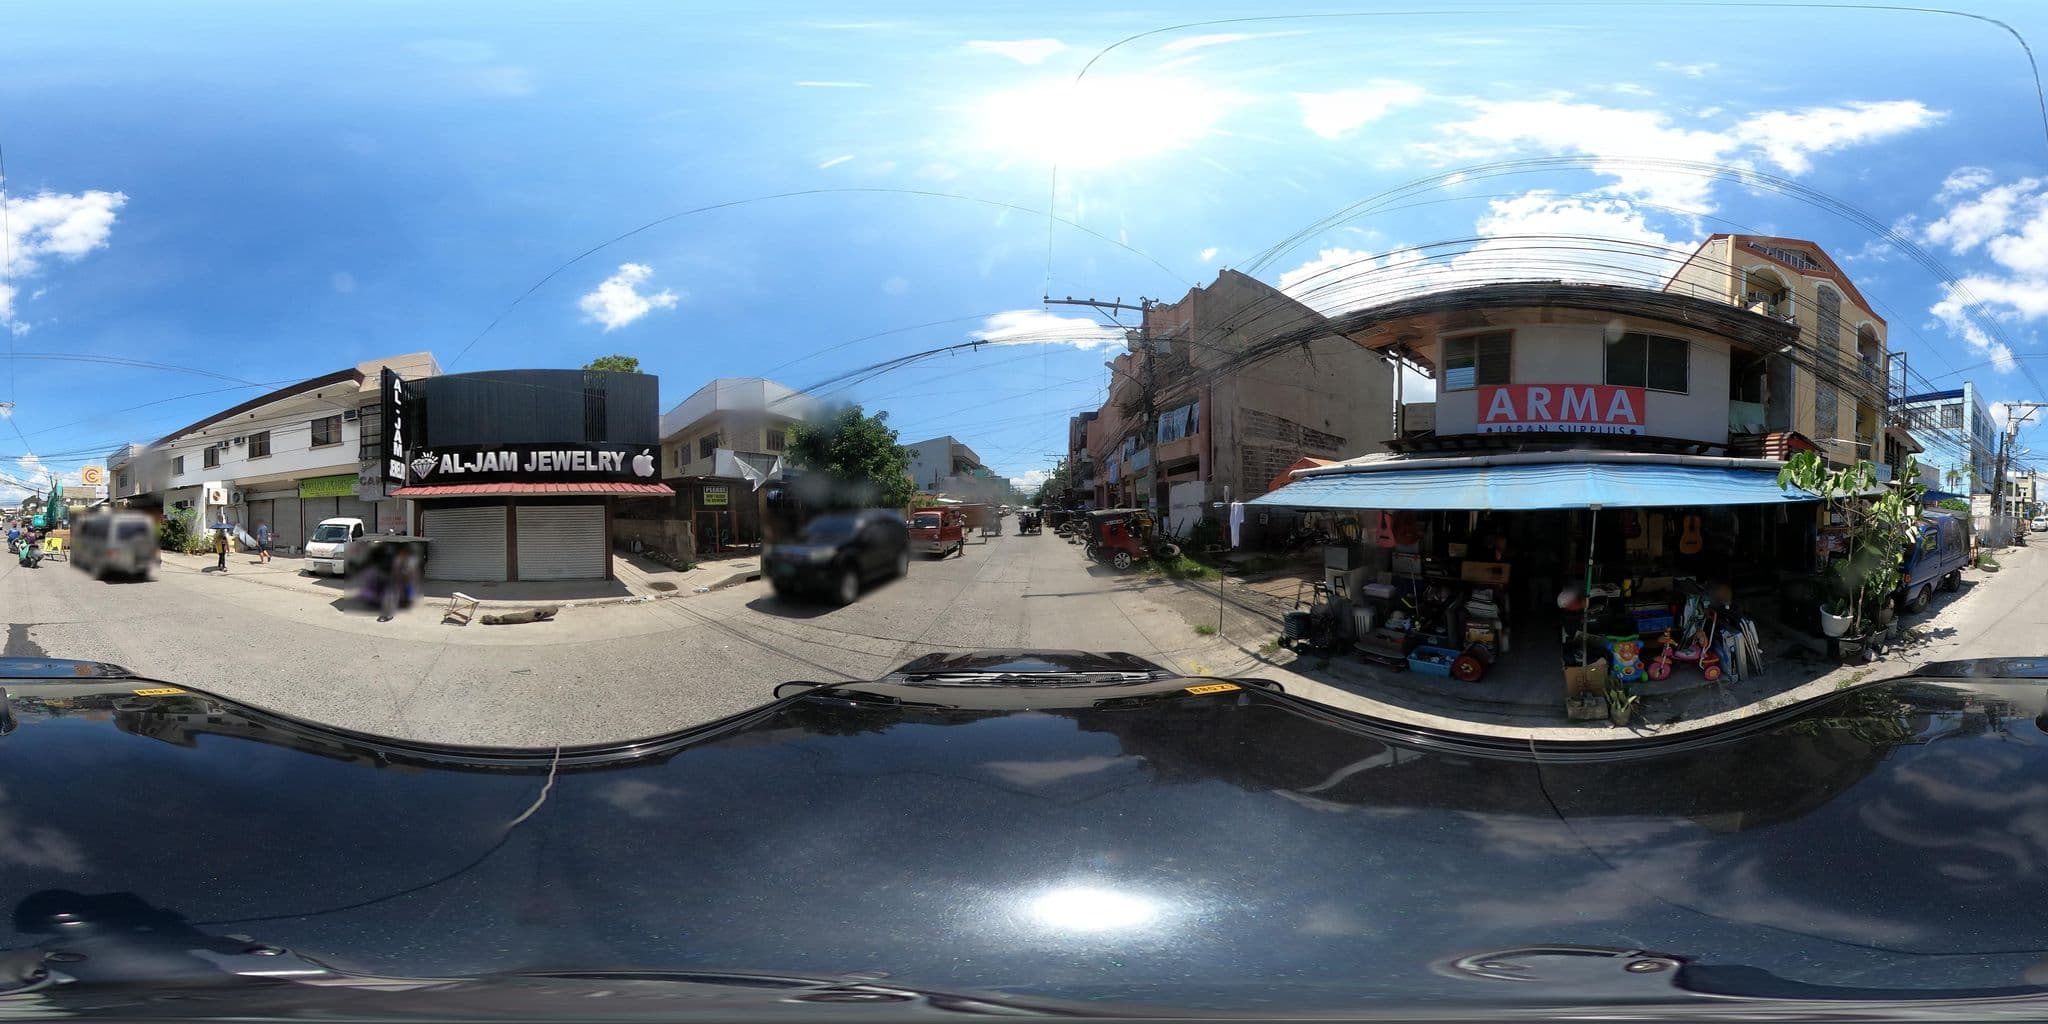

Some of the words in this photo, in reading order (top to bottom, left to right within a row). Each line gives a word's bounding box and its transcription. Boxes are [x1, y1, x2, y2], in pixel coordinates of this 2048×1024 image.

[393, 378, 403, 458] AL-JAM
[1485, 386, 1637, 422] ARMA
[439, 451, 519, 474] AL-JAM
[524, 451, 626, 472] JEWELRY
